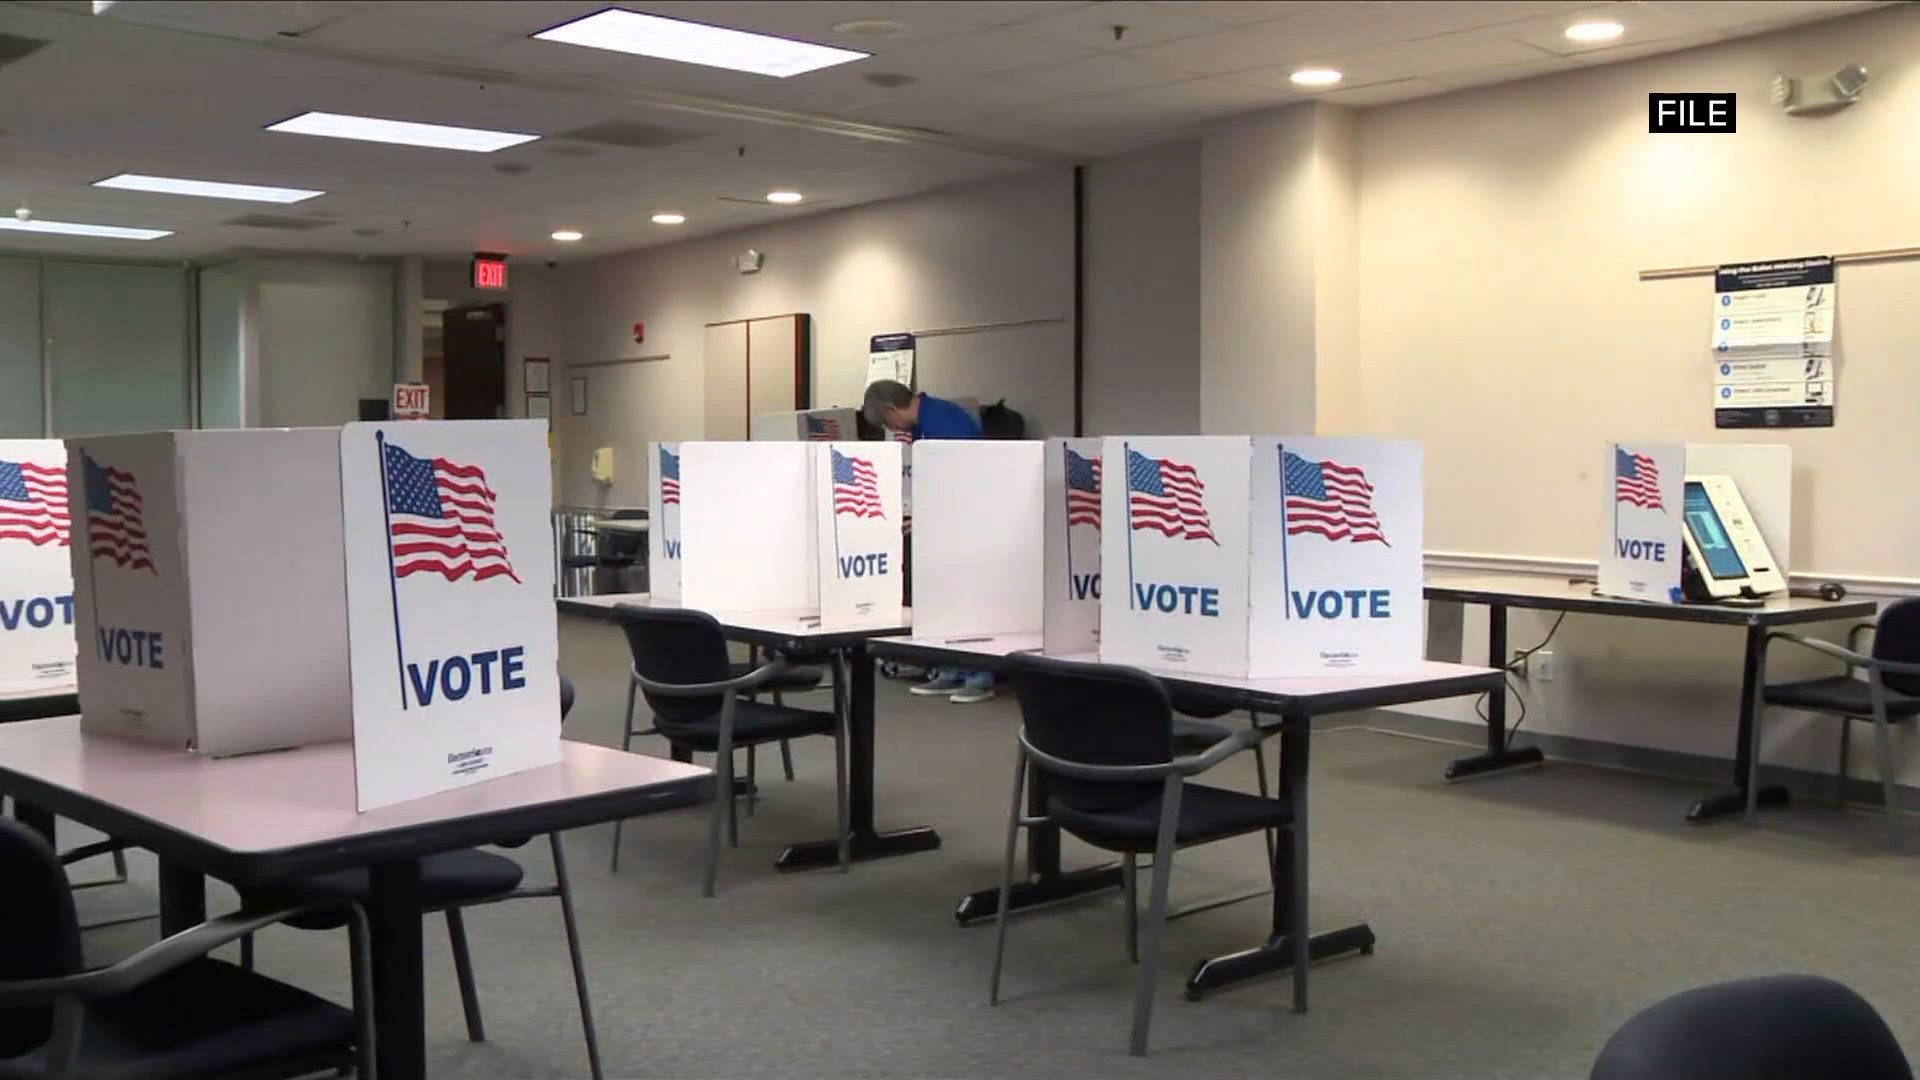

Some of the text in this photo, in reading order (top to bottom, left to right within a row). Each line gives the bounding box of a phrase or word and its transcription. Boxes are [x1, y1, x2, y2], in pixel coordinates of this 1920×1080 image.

[478, 262, 505, 287] EXIT
[396, 388, 427, 409] EXIT
[1618, 538, 1665, 562] VOTE
[840, 553, 888, 578] VOTE
[1135, 582, 1219, 617] VOTE
[1291, 589, 1391, 619] VOTE
[100, 625, 164, 669] VOTE
[407, 645, 526, 707] VOTE
